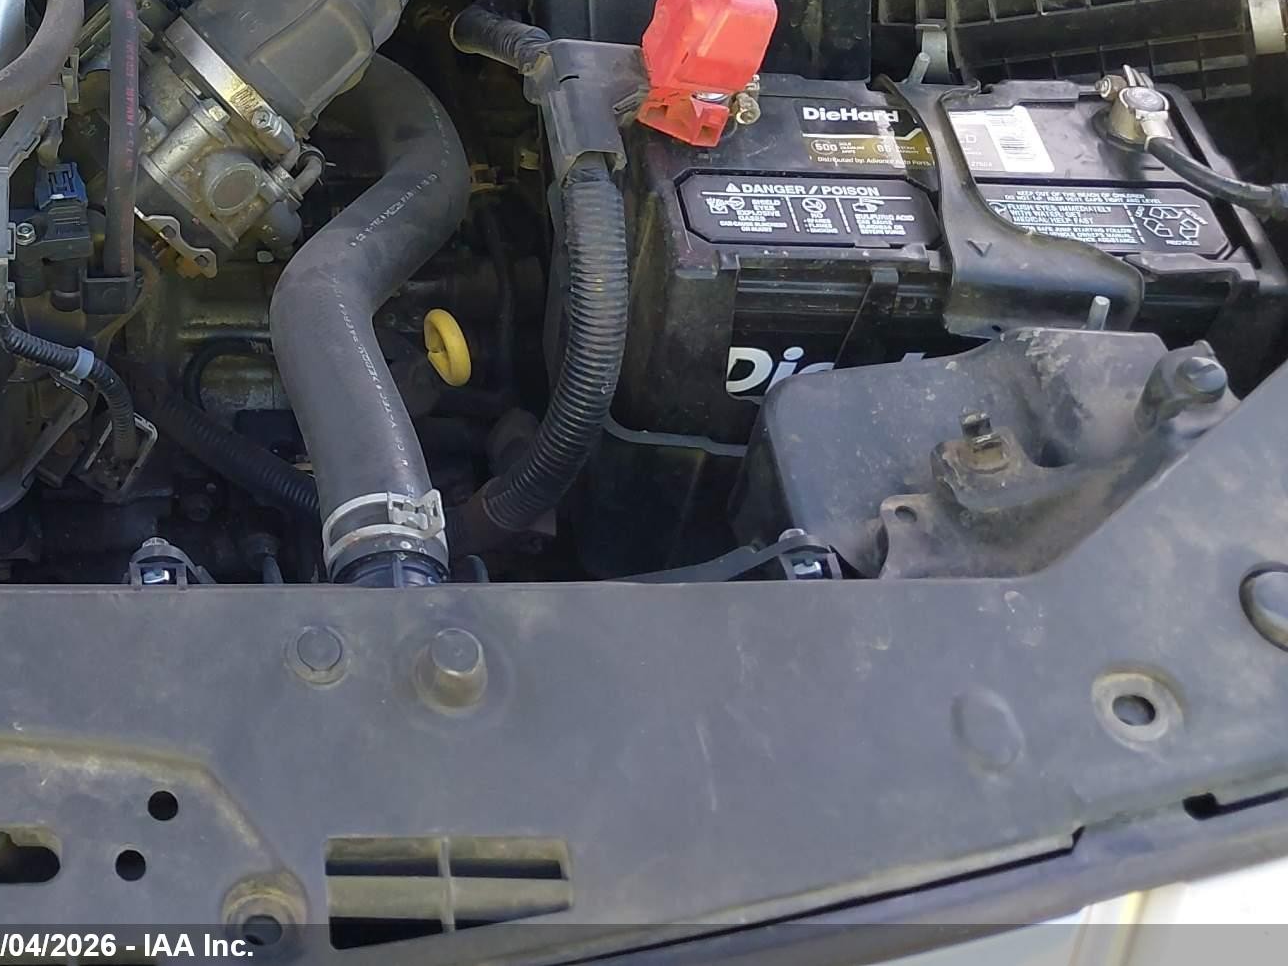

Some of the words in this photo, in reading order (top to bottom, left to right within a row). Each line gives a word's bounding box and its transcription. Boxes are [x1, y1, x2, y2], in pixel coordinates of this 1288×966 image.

[802, 106, 899, 123] DieHard
[814, 143, 838, 152] 500
[741, 183, 807, 195] DANGER
[808, 185, 818, 195] /
[820, 185, 880, 197] POISON
